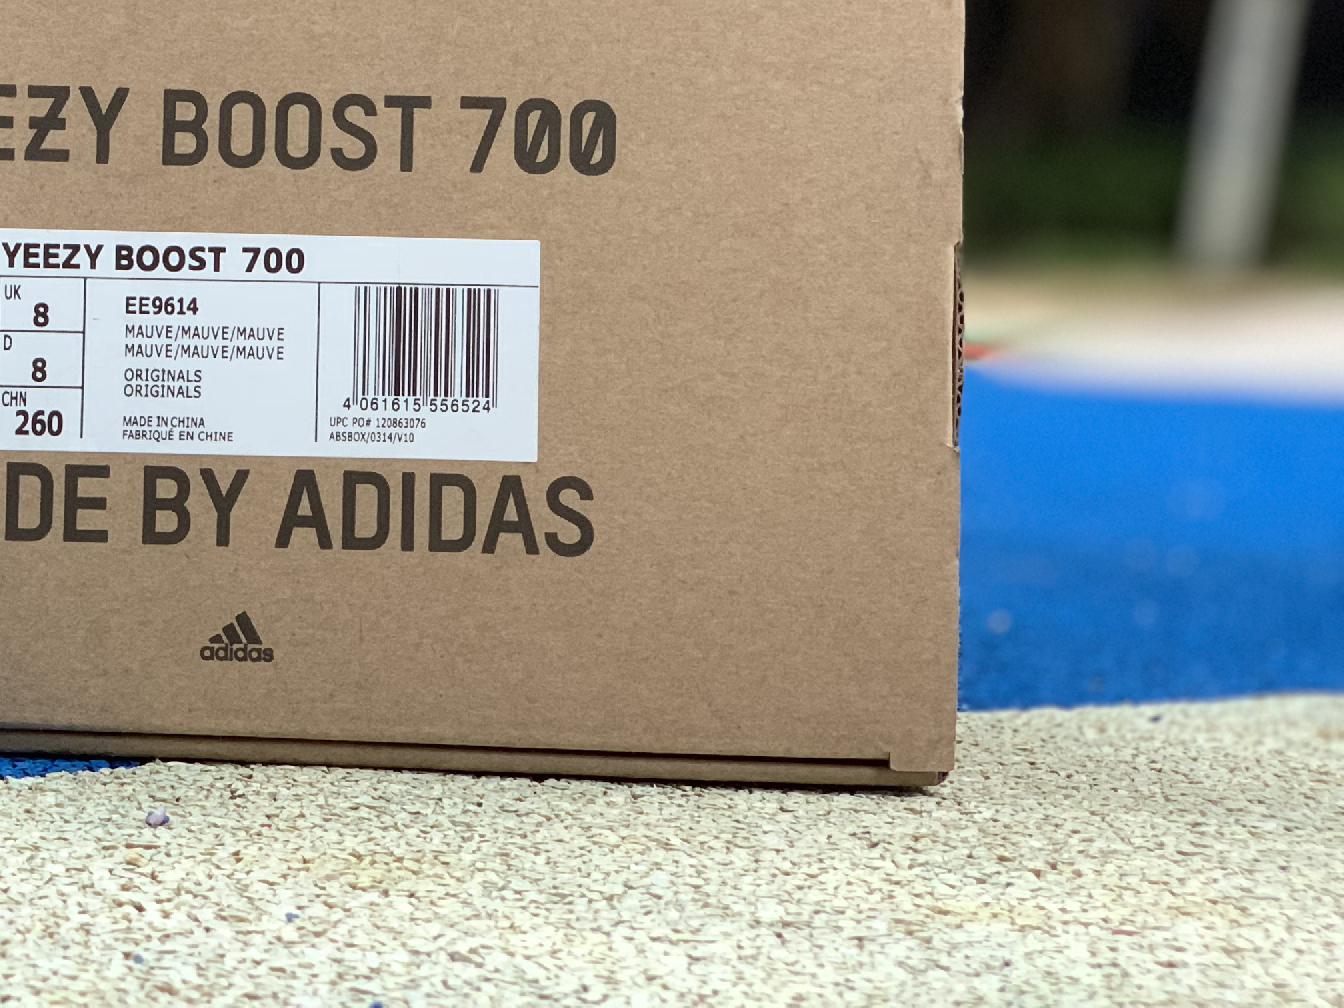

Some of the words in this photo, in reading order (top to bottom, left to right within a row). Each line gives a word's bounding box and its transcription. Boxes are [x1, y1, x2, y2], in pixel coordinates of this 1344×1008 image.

[161, 89, 433, 173] BOOST
[459, 96, 618, 177] 700
[1, 242, 105, 270] YEEZY
[115, 244, 227, 273] BOOST
[241, 246, 305, 275] 700
[4, 284, 22, 301] UK
[32, 302, 50, 328] 8
[125, 295, 199, 316] EE9614
[3, 334, 13, 351] D
[124, 323, 285, 343] MAUVE/MAUVE/MAUVE
[124, 343, 285, 362] MAUVE/MAUVE/MAUVE
[31, 357, 47, 383] 8
[123, 367, 202, 383] ORIGINALS
[1, 390, 27, 407] CHN
[123, 383, 202, 399] ORIGINALS
[14, 409, 63, 437] 260
[122, 415, 153, 428] MADE
[155, 415, 169, 428] IN
[170, 416, 206, 429] CHINA
[329, 415, 349, 428] UPC
[352, 416, 372, 428] PO#
[375, 417, 426, 429] 120863076
[178, 430, 195, 441] EN
[197, 430, 234, 442] CHINE
[141, 465, 251, 548] BY
[274, 469, 596, 558] ADIDAS
[199, 644, 275, 663] adidas
